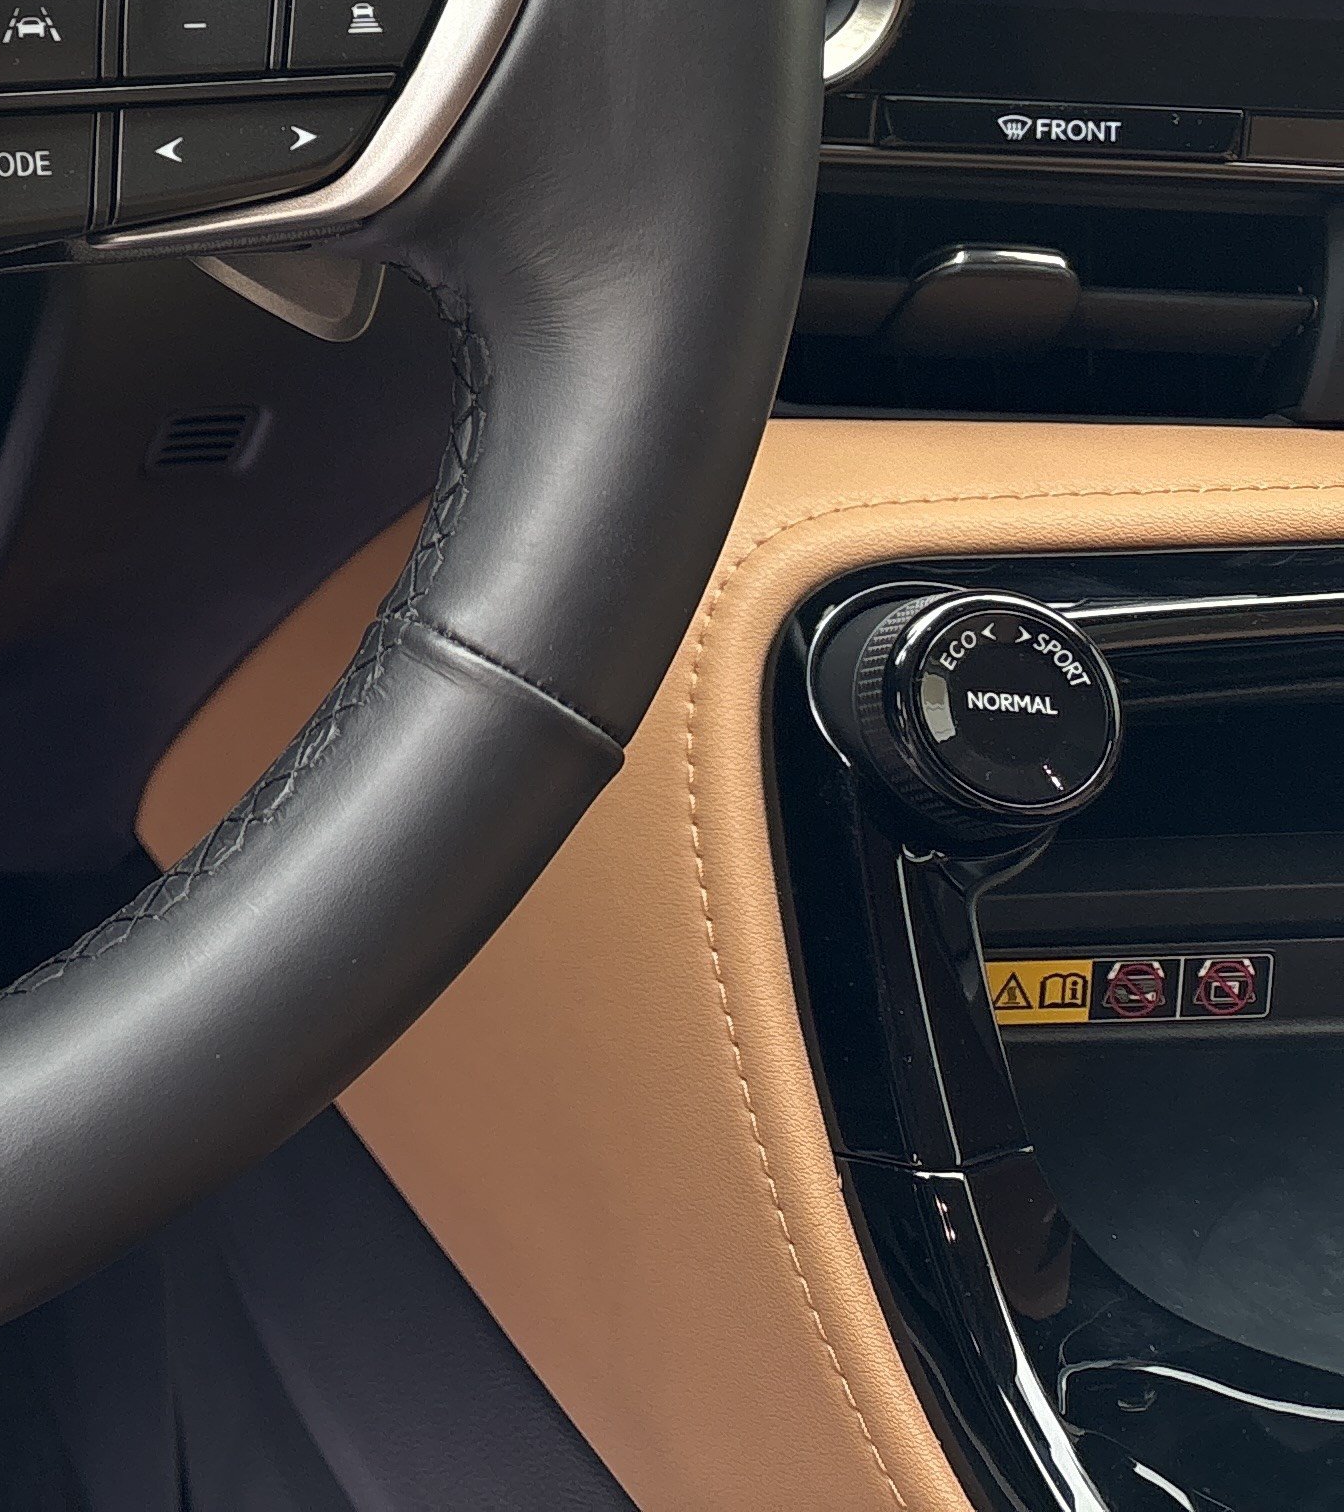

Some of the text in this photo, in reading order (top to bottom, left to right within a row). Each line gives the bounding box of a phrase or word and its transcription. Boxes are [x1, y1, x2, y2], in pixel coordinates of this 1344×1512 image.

[1035, 119, 1122, 143] FRONT
[939, 630, 978, 671] ECO
[1032, 633, 1092, 687] SPORT
[966, 690, 1059, 716] NORMAL
